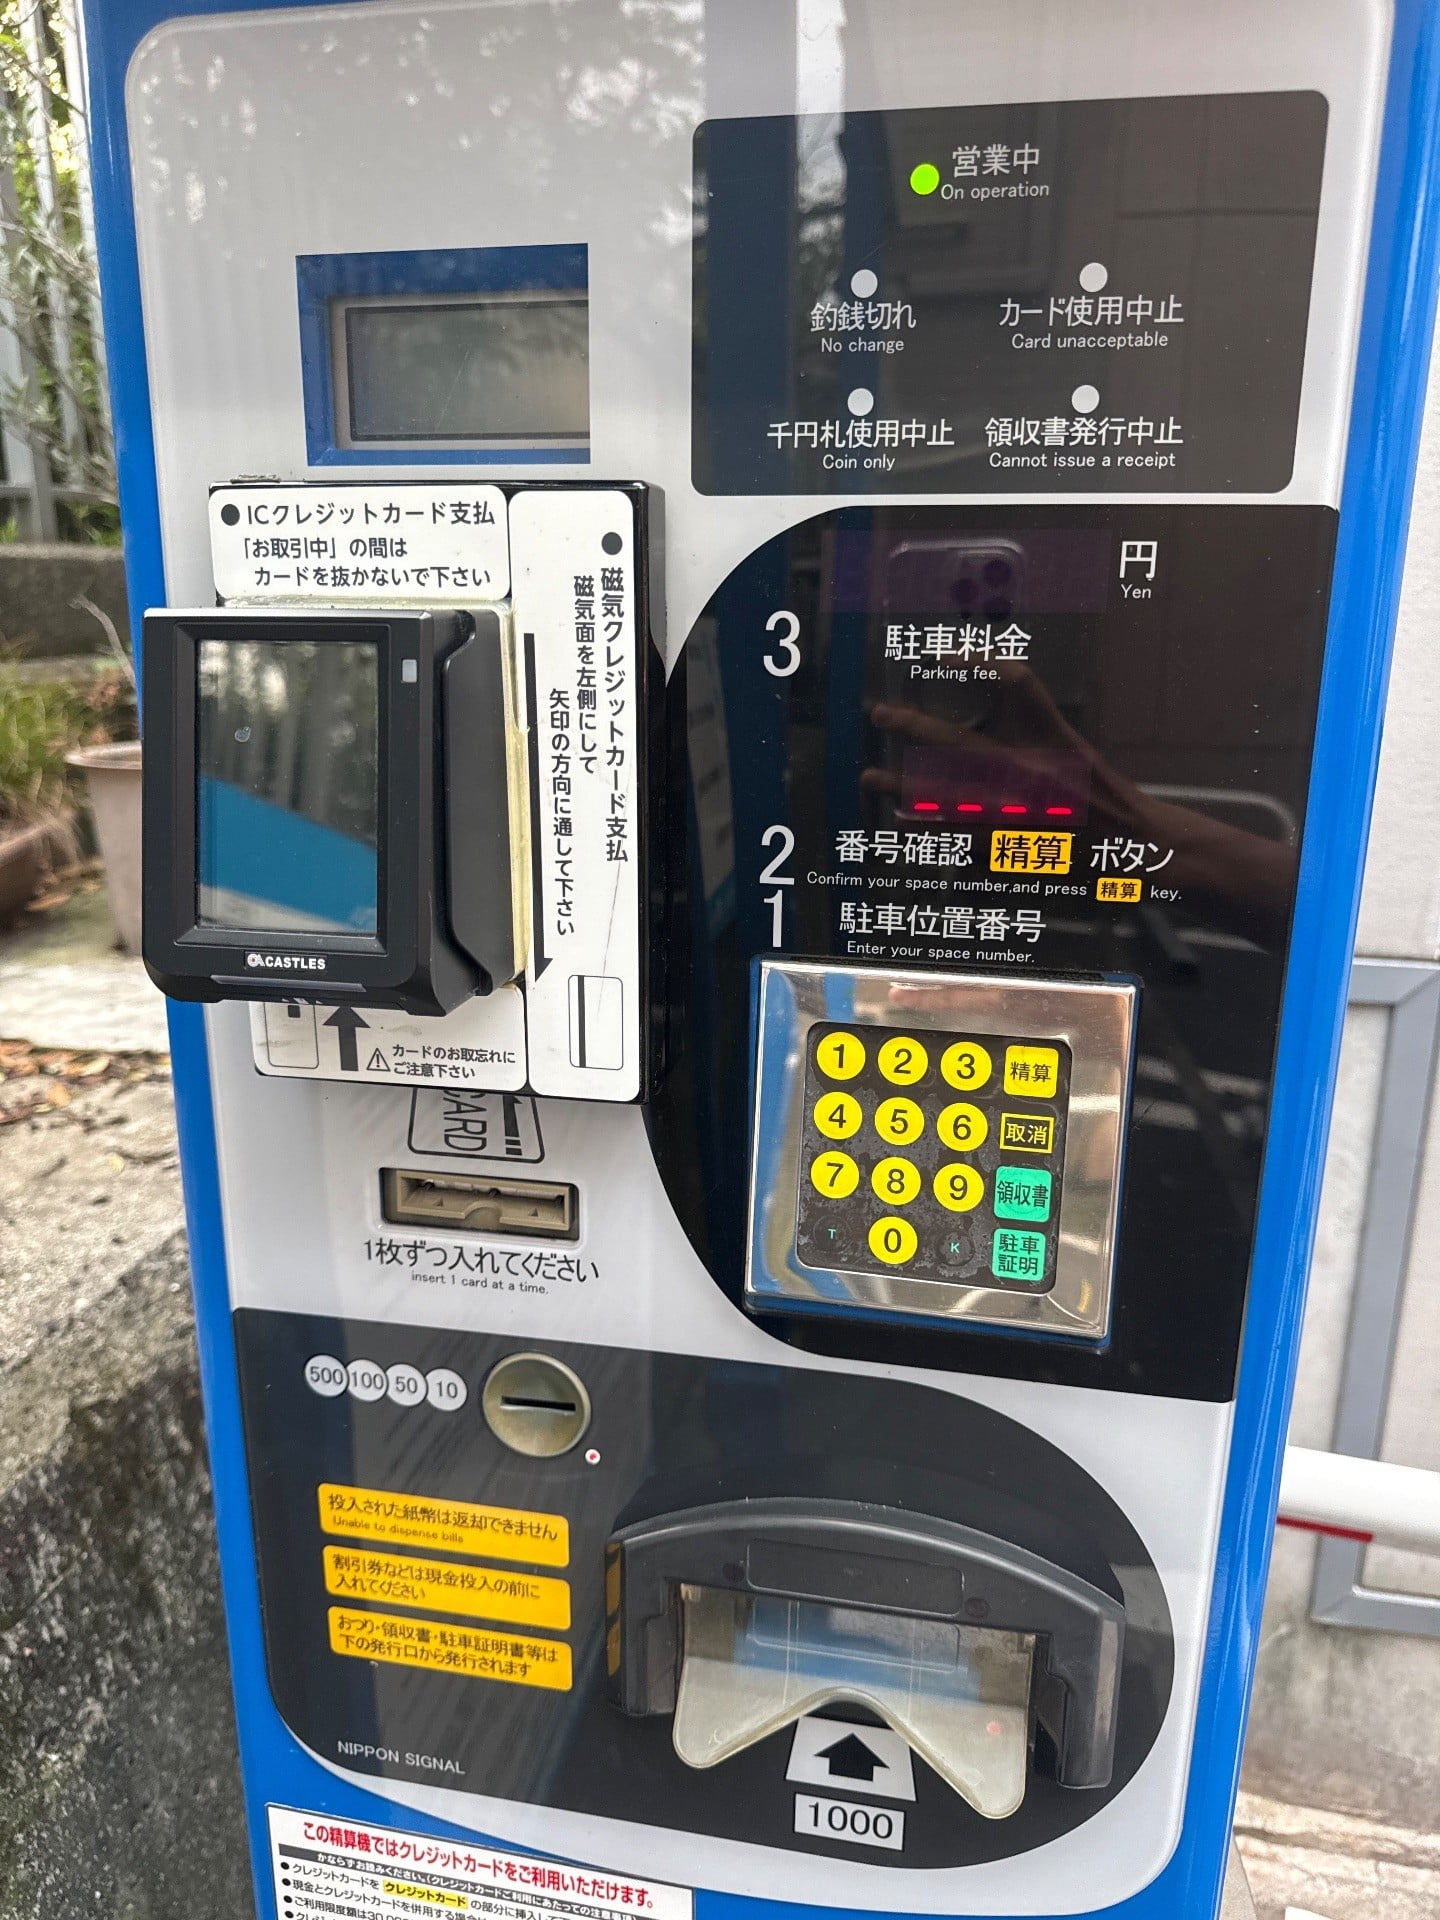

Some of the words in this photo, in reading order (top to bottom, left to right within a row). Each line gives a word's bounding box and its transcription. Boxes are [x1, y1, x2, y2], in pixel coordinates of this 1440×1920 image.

[951, 142, 1041, 178] 営業中
[940, 184, 967, 200] On
[971, 181, 1050, 201] operation
[810, 302, 917, 332] 釣銭切れ
[999, 295, 1185, 328] カード使用中止
[820, 337, 843, 353] No
[848, 337, 905, 355] change
[1011, 332, 1052, 349] Card
[1058, 331, 1169, 350] unacceptable
[767, 418, 955, 448] 千円札使用中止
[985, 417, 1184, 448] 領収書発行中止
[821, 453, 857, 471] Coin
[862, 454, 897, 473] only
[989, 454, 1048, 469] Cannot
[1053, 453, 1096, 468] issue
[1102, 456, 1112, 467] a
[1117, 452, 1177, 471] receipt
[246, 501, 496, 527] ICクレジットカード支払
[254, 564, 492, 588] カードを抜かないで下さい
[1119, 540, 1158, 579] 円
[1120, 583, 1152, 600] Yen
[763, 610, 801, 678] 3
[884, 623, 1033, 662] 駐車料金
[573, 574, 598, 775] 磁気面を左側にして
[910, 664, 968, 683] Parking
[972, 664, 1002, 681] fee.
[600, 566, 629, 863] 磁気クレジットカード支払
[549, 687, 575, 936] 矢印の方向に通して下さい
[760, 824, 795, 886] 2
[835, 829, 973, 867] 番号確認
[994, 834, 1069, 871] 精算
[1090, 837, 1175, 874] ボタン
[806, 871, 863, 887] Confirm
[867, 875, 900, 891] your
[905, 876, 948, 892] space
[1044, 882, 1088, 897] press
[1099, 881, 1139, 899] 精算
[1149, 885, 1182, 901] key.
[763, 889, 782, 948] 1
[839, 901, 1047, 943] 駐車位置番号
[265, 955, 327, 970] CASTLES
[847, 940, 887, 956] Enter
[890, 944, 925, 959] your
[928, 945, 971, 961] space
[975, 947, 1036, 964] number.
[392, 1043, 517, 1065] カードのお取忘れに
[832, 1043, 846, 1069] 1
[893, 1048, 912, 1074] 2
[956, 1053, 976, 1079] 3
[1010, 1061, 1052, 1083] 精算
[392, 1062, 476, 1080] ご注意下さい
[828, 1103, 847, 1129] 4
[890, 1109, 909, 1134] 5
[952, 1114, 972, 1140] 6
[1005, 1122, 1049, 1146] 取消
[827, 1163, 844, 1188] 7
[886, 1168, 906, 1194] 8
[949, 1174, 969, 1201] 9
[996, 1182, 1049, 1209] 領収書
[828, 1229, 837, 1240] T
[883, 1228, 902, 1254] 0
[950, 1242, 960, 1254] K
[998, 1233, 1040, 1255] 駐車
[363, 1237, 600, 1283] 1枚ずつ入れてください
[998, 1254, 1039, 1275] 証明
[411, 1270, 447, 1285] insert
[461, 1275, 488, 1289] card
[492, 1279, 504, 1290] at
[519, 1280, 550, 1295] time.
[309, 1366, 344, 1386] 500
[350, 1371, 385, 1391] 100
[395, 1375, 419, 1394] 50
[437, 1381, 458, 1399] 10
[328, 1493, 558, 1542] 投入された紙幣は返却できません
[332, 1515, 371, 1531] Unable
[373, 1522, 386, 1533] to
[389, 1523, 439, 1542] dispense
[332, 1552, 541, 1599] 割引券などは現金投入の前に
[335, 1573, 427, 1601] 入れてください
[337, 1613, 559, 1663] おつり・領収書・駐車証明書等は
[339, 1633, 533, 1678] 下の発行口から発行されます
[337, 1739, 400, 1765] NIPPON
[404, 1750, 467, 1776] SIGNAL
[808, 1801, 893, 1839] 1000
[302, 1821, 654, 1909] この精算機ではクレジットカードをご利用いただけます。
[292, 1863, 380, 1890] クレジットカードを
[384, 1882, 467, 1907] クレジットカード
